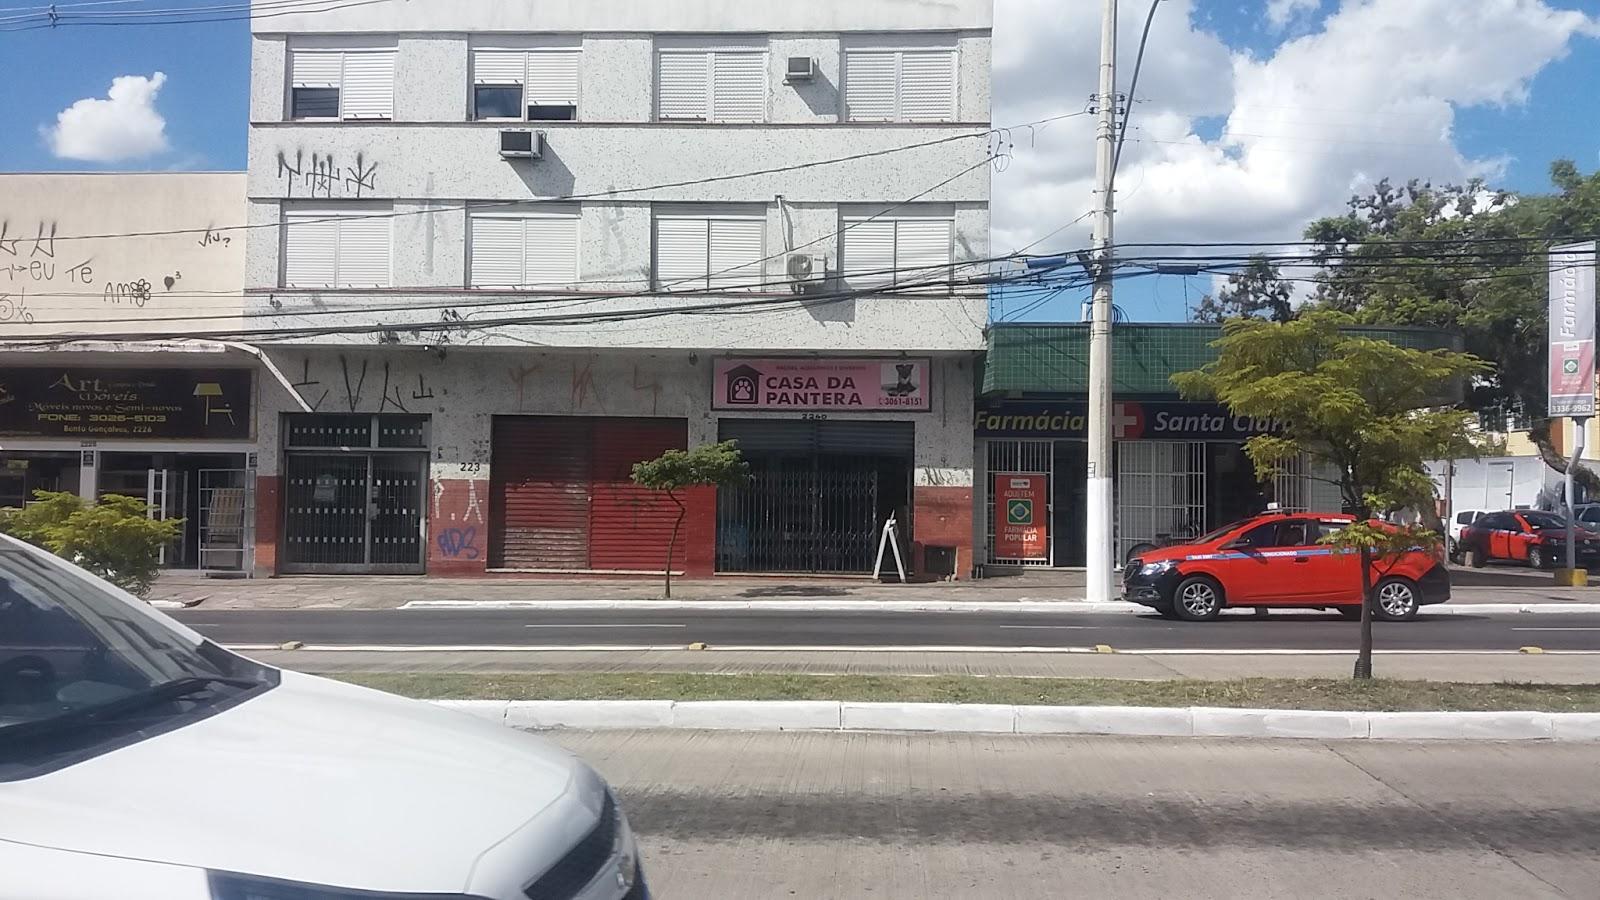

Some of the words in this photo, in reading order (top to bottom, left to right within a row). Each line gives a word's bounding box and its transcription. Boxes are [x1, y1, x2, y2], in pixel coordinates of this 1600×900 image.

[766, 376, 819, 389] CASA
[827, 376, 856, 389] DA
[766, 392, 863, 405] PANTERA
[38, 413, 81, 421] FONE:
[974, 410, 1085, 431] Farmácia
[1154, 411, 1225, 432] Santa
[460, 462, 481, 472] 223
[1004, 534, 1038, 542] POPULAR
